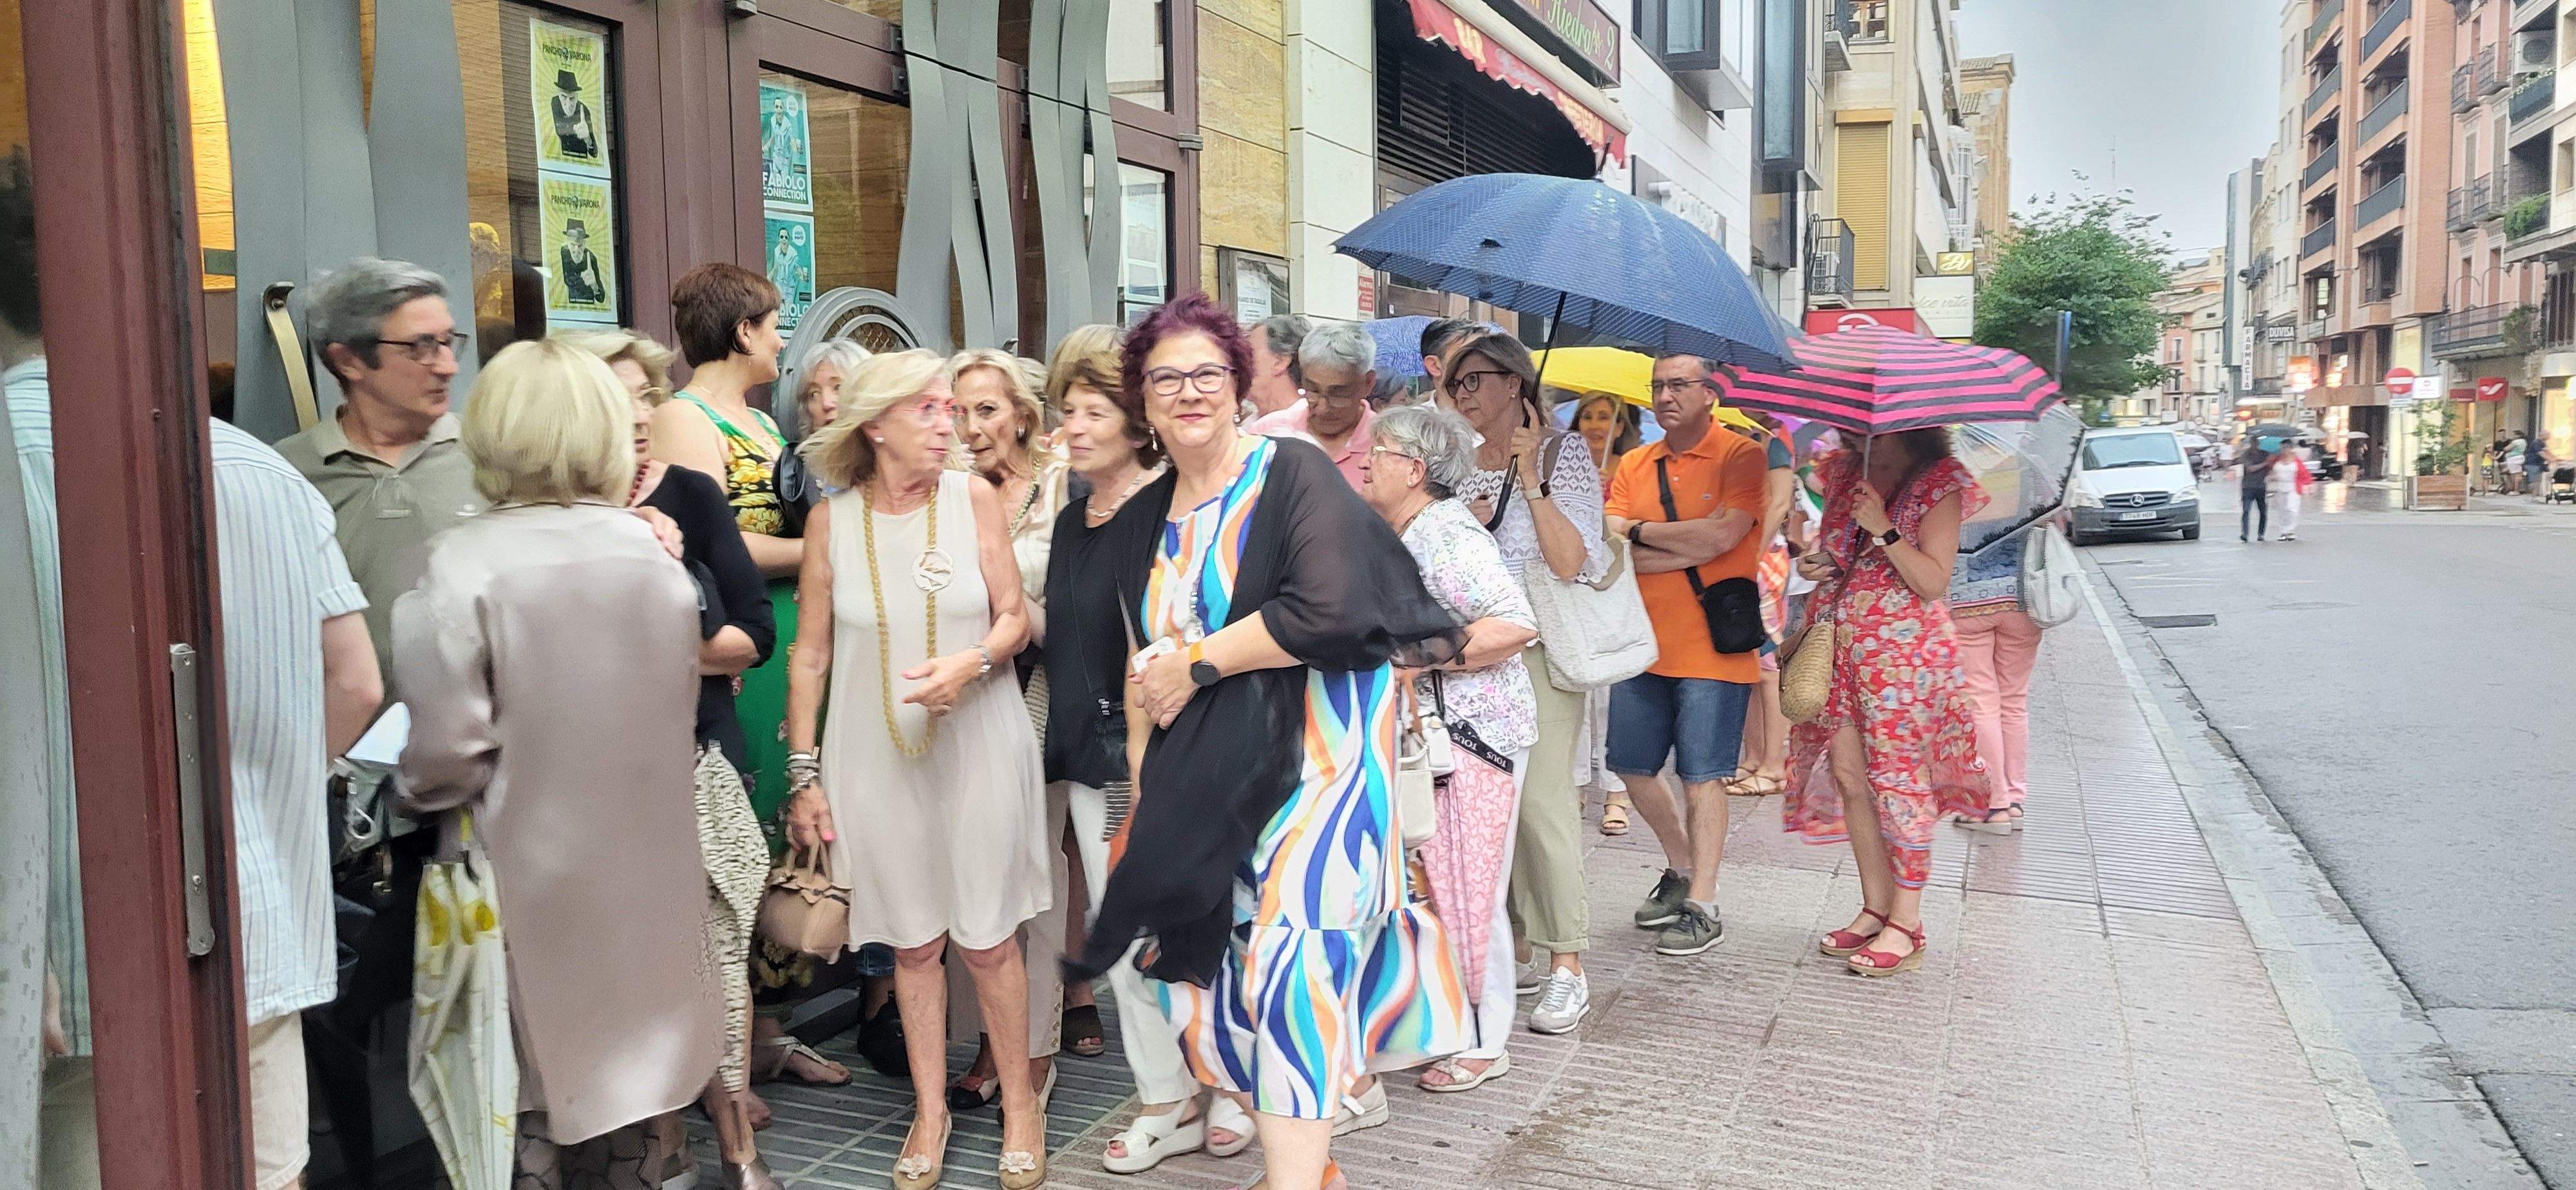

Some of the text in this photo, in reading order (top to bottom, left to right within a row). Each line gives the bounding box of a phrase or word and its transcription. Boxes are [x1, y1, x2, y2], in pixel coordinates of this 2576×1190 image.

[542, 43, 592, 62] PANCHO VARONA
[1605, 26, 1615, 71] 2
[762, 171, 806, 191] FABIOLO
[551, 195, 600, 209] PANCHO VARONA
[763, 186, 806, 201] CONNECTION
[779, 303, 810, 317] BIOL
[777, 316, 799, 327] NNECT
[1452, 733, 1507, 768] TOUS TOUS
